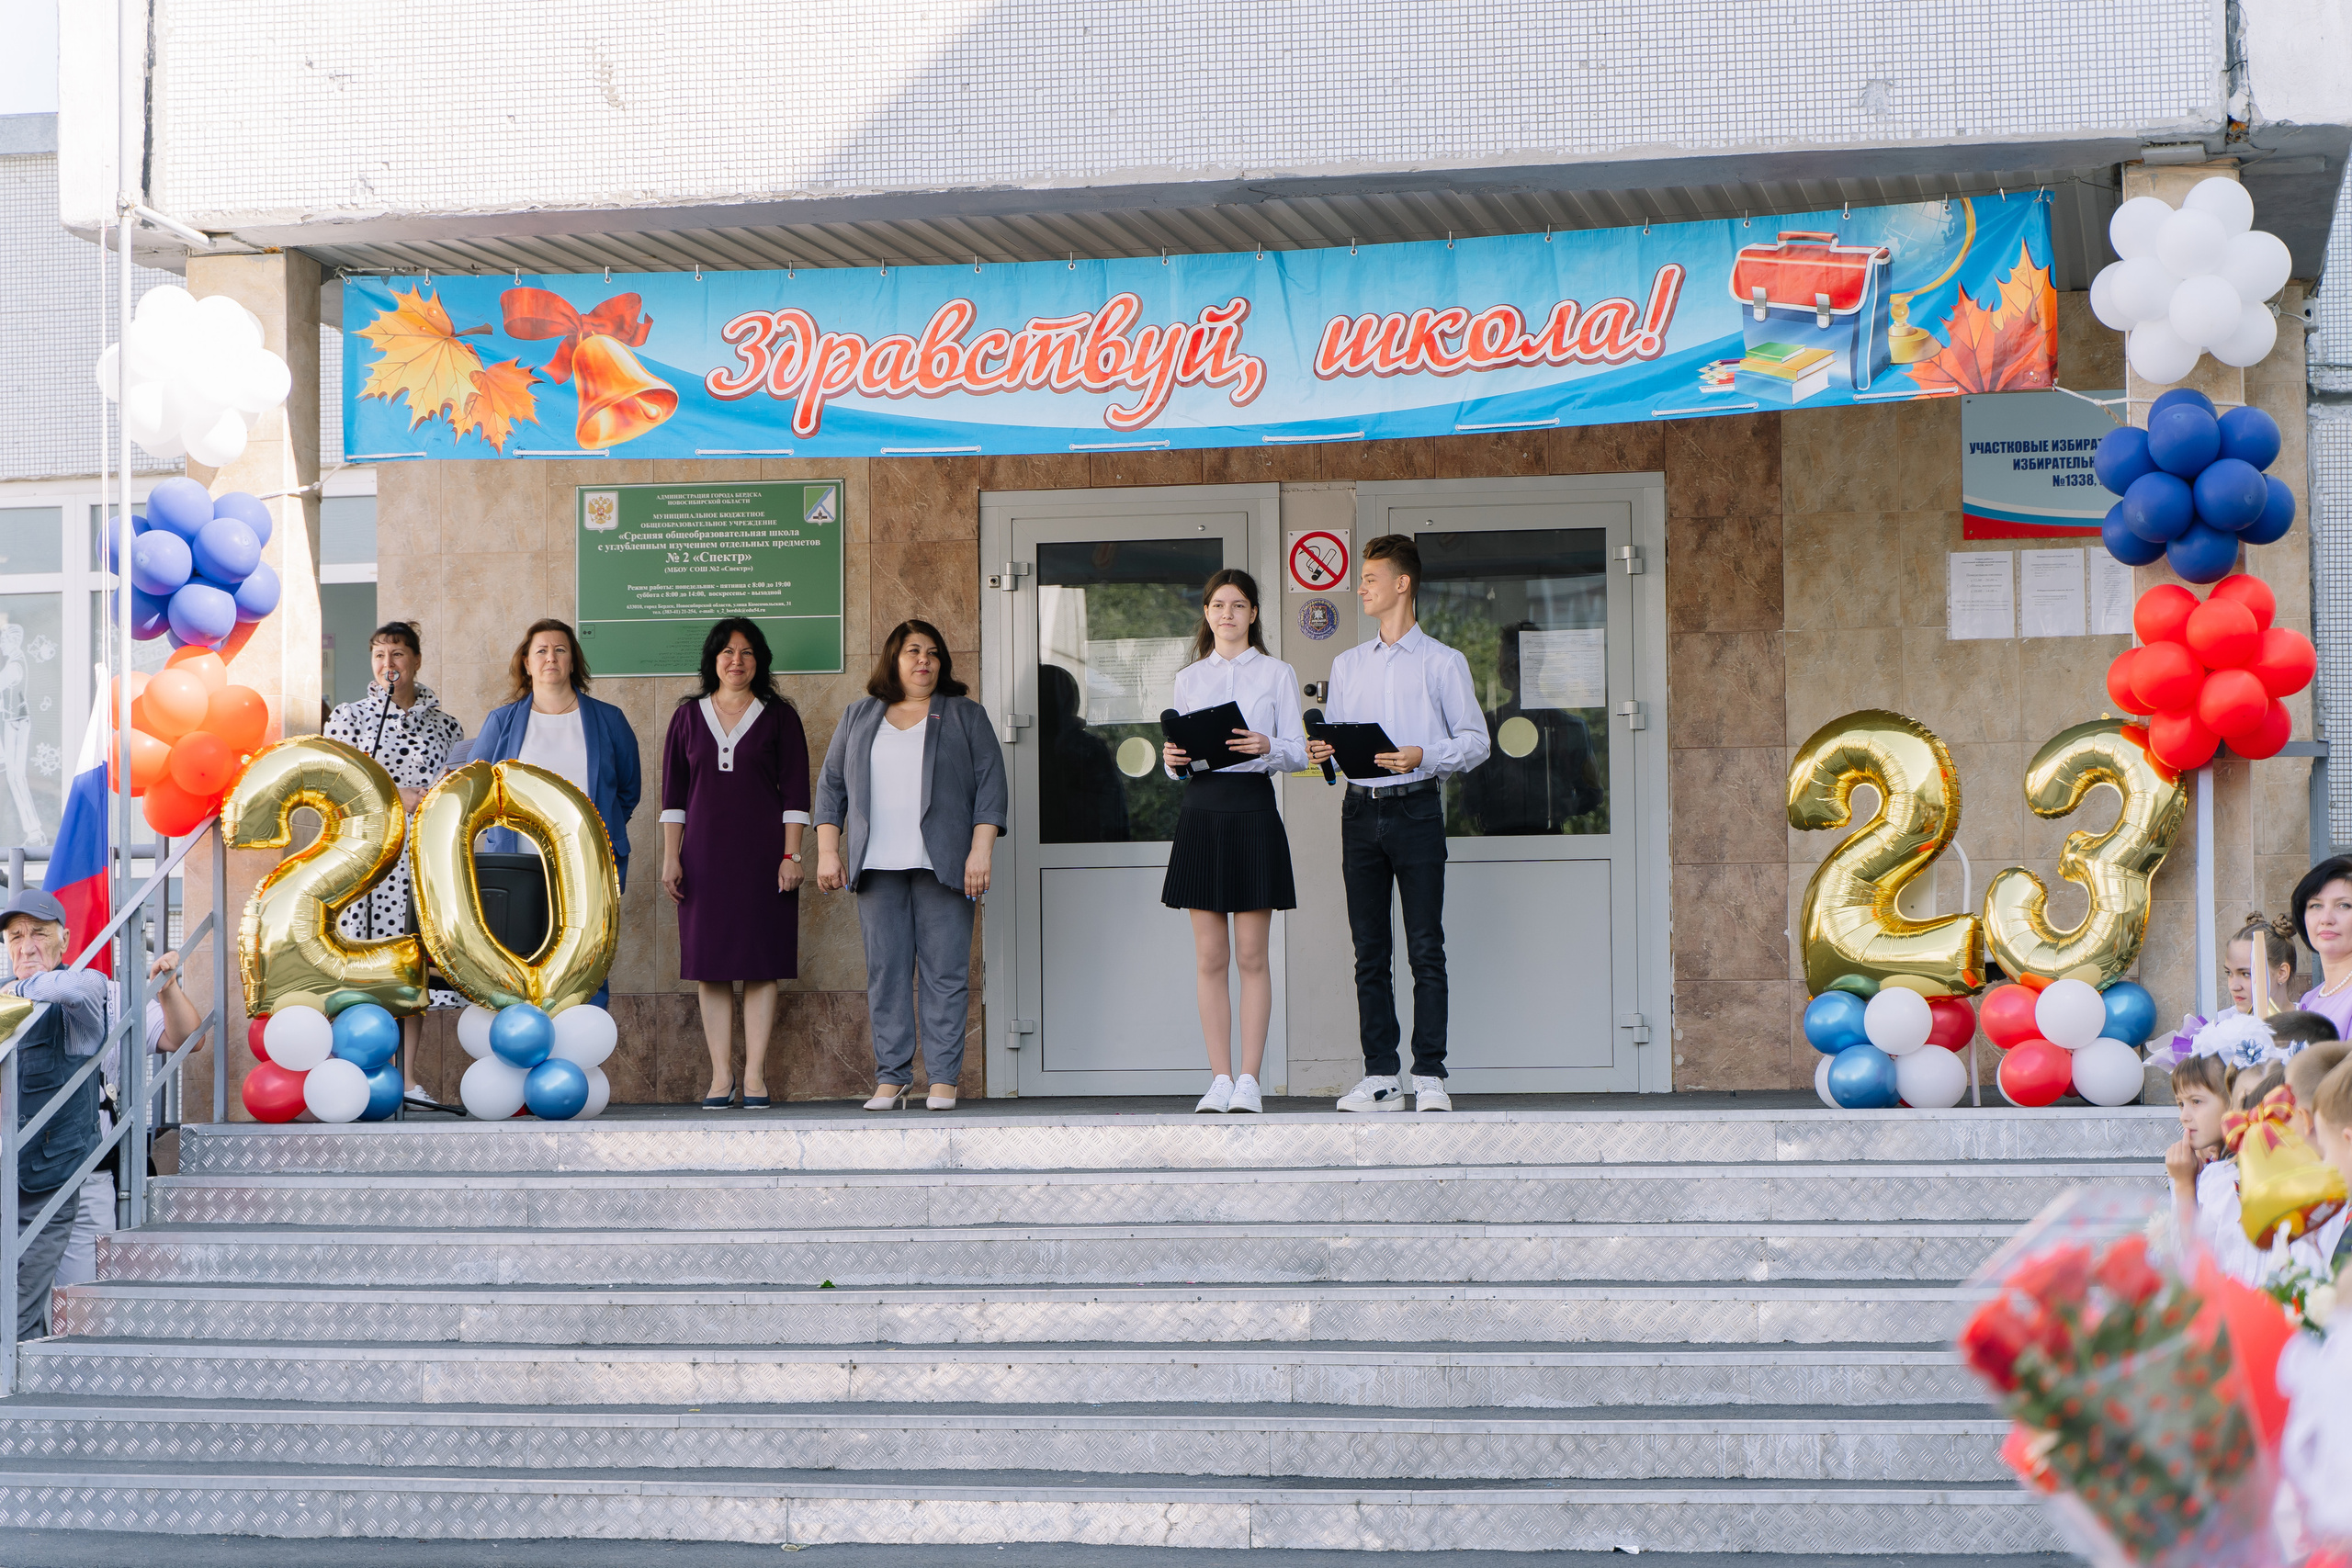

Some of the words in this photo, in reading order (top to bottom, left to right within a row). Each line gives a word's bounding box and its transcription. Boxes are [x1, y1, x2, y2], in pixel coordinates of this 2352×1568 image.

[705, 292, 1267, 439] Здравствуй,
[1314, 264, 1686, 380] школа!
[1969, 440, 2049, 454] УЧАСТКОВЫЕ
[2052, 474, 2097, 487] №1338,
[618, 532, 663, 542] «Средняя
[666, 530, 766, 540] общеобразовательная
[605, 542, 666, 552] углубленным
[669, 542, 717, 551] изучением
[719, 540, 769, 548] отдельных
[772, 539, 820, 548] предметов
[666, 552, 680, 563] №
[683, 552, 689, 562] 2
[693, 552, 752, 564] «Спектр»
